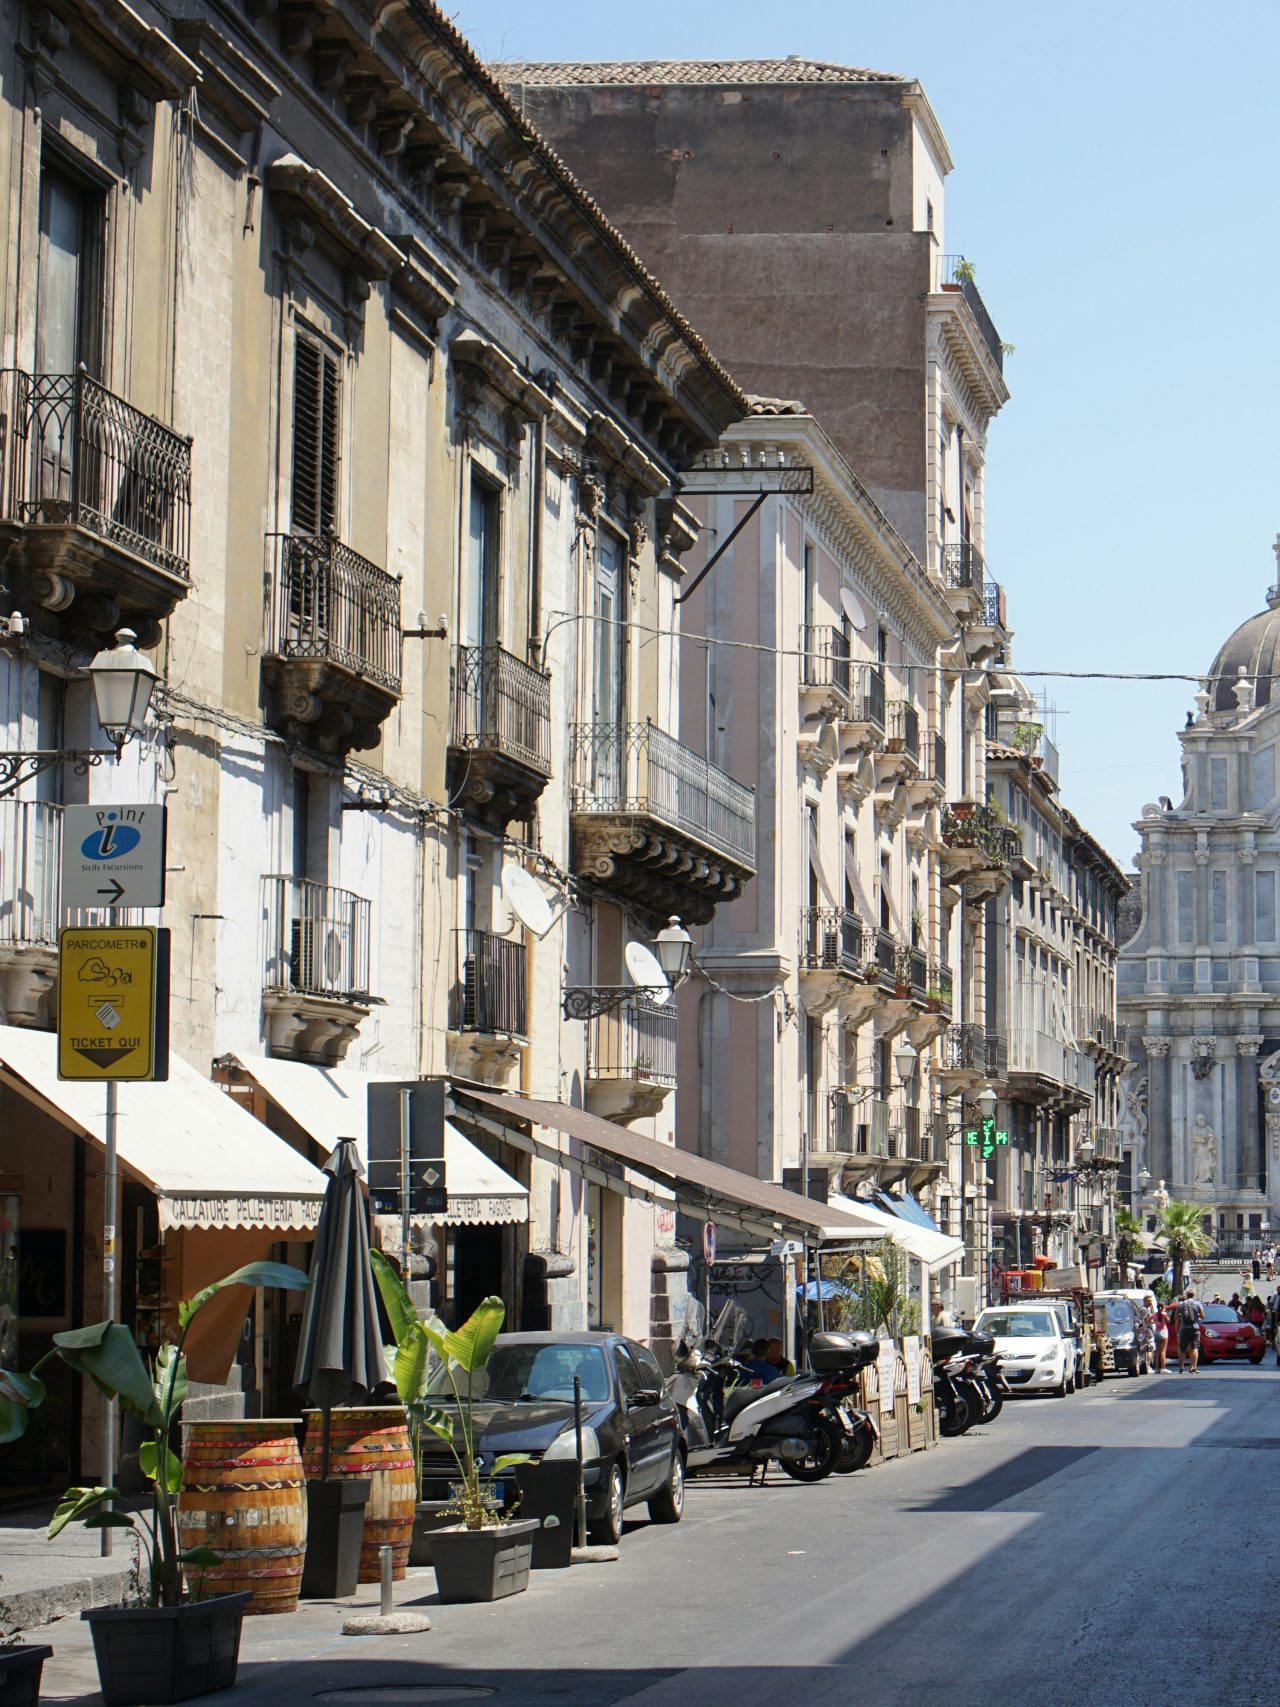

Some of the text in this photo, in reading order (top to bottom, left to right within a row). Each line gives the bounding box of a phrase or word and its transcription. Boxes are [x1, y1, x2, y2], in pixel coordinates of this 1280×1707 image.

[81, 863, 144, 872] Sicily Excursions
[70, 1037, 141, 1048] TICKET QUI
[173, 1197, 229, 1222] CALZATURE
[236, 1198, 293, 1222] PELLETTERIA
[488, 1200, 512, 1217] FAGONE
